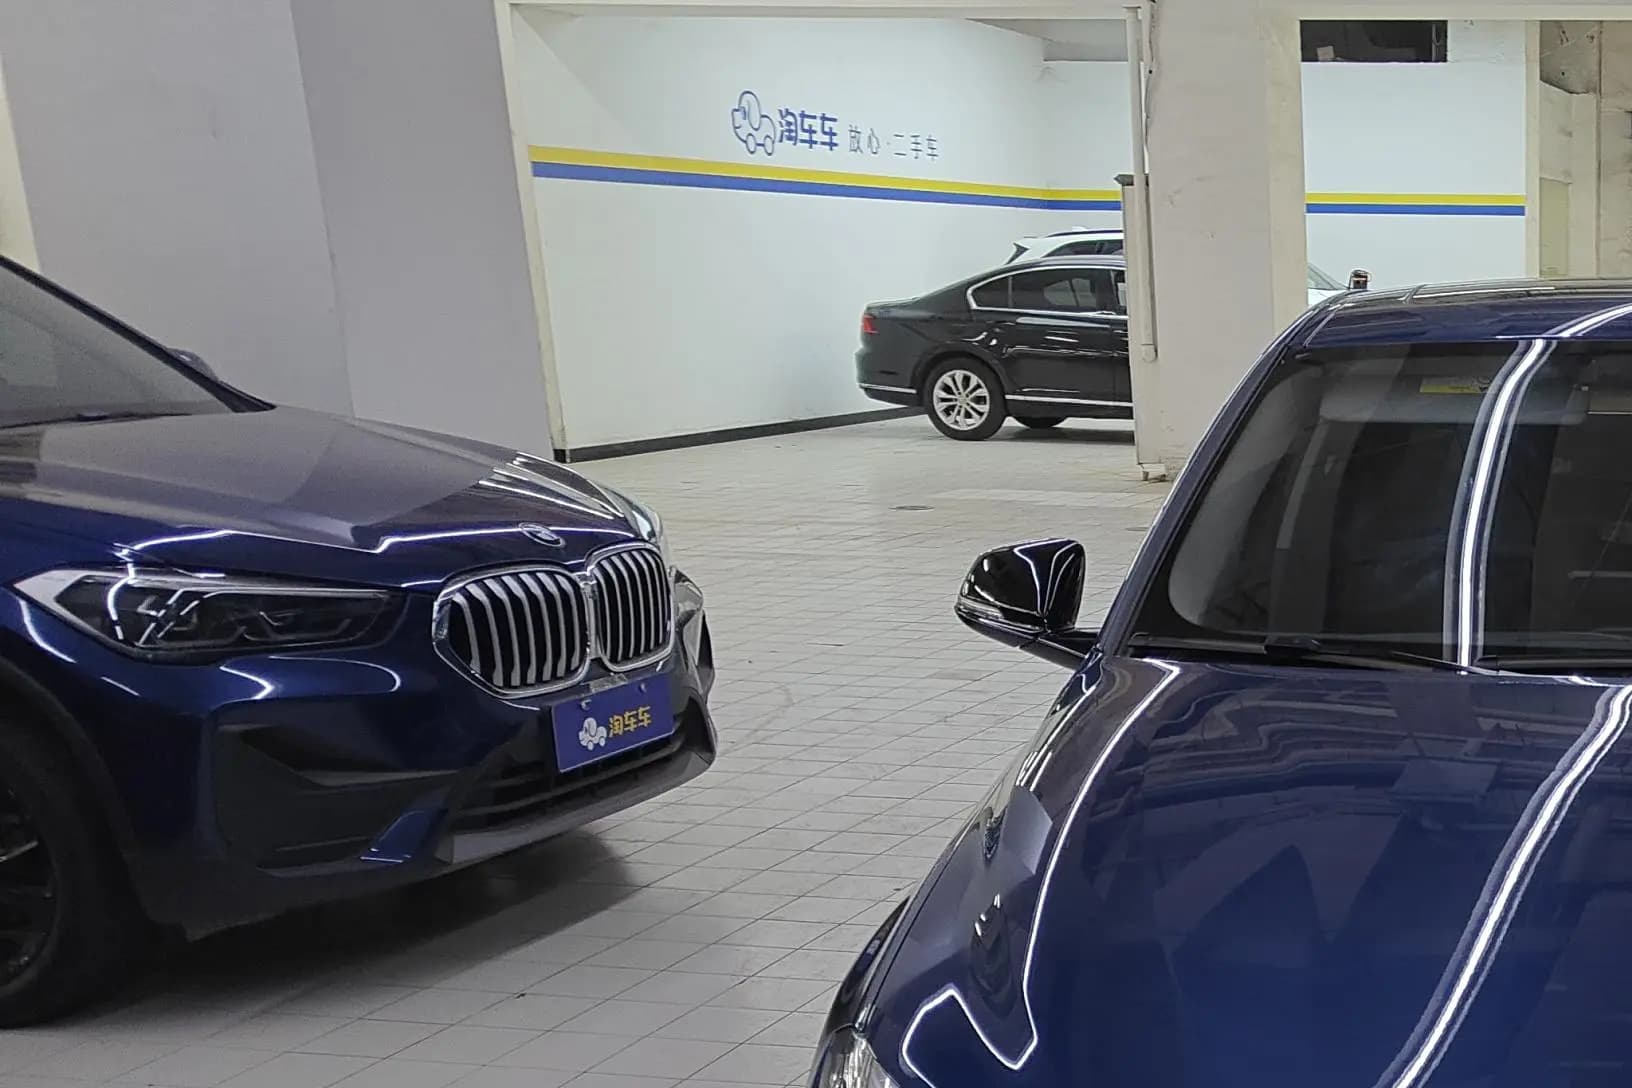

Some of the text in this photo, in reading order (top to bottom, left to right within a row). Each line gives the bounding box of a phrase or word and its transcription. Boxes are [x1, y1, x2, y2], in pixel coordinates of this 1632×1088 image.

[777, 108, 839, 151] 淘车车
[609, 705, 652, 738] 淘车车
